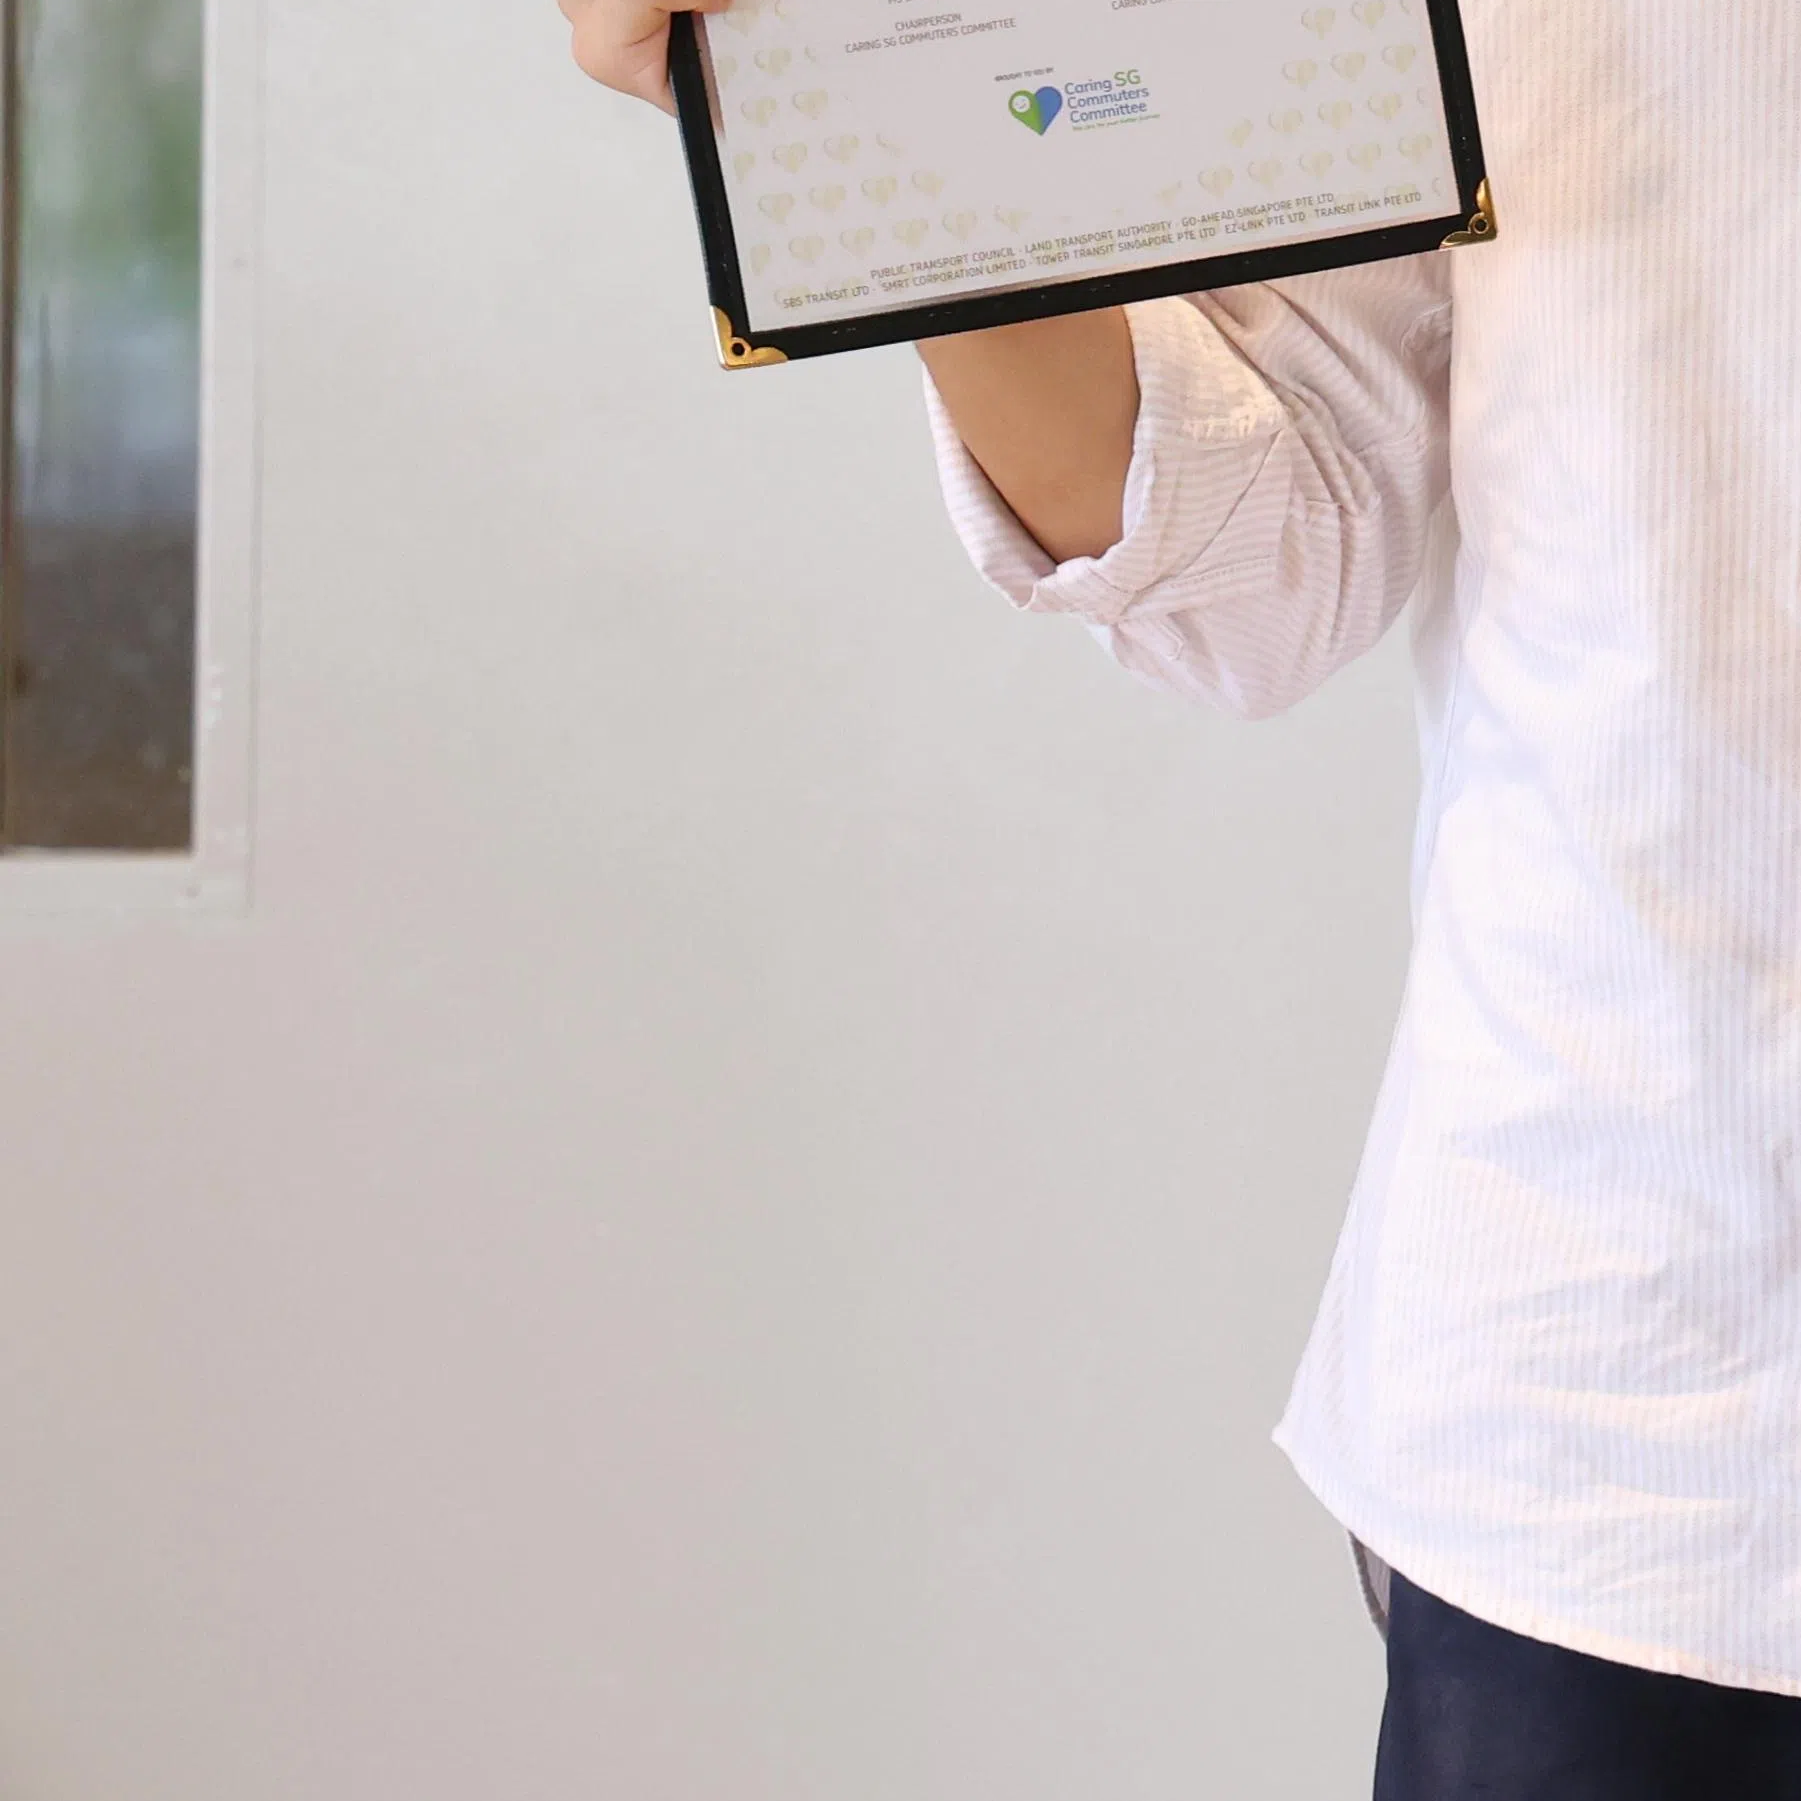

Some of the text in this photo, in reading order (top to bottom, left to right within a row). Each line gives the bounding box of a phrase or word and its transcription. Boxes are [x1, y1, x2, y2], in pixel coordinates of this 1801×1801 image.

[895, 13, 962, 31] CHAIRPERSON
[845, 18, 1016, 54] CARING SG COMMUTERS COMMITTEE
[1065, 69, 1141, 95] Caring SG
[1067, 86, 1149, 109] Commuters
[1070, 102, 1147, 123] Committee
[870, 193, 1334, 280] PUBLIC TRANSPORT COUNCIL LAND TRANSPORT AUTHORITY GO-AHEAD SINGAPORE PTE LTD
[783, 192, 1421, 309] SBS TRANSIT LTD SMRT CORPORATION LIMITED TOWER TRANSIT SINGAPORE PTE LTD EZ-LINK PTE LTD TRANSIT LINK PTE LTD
